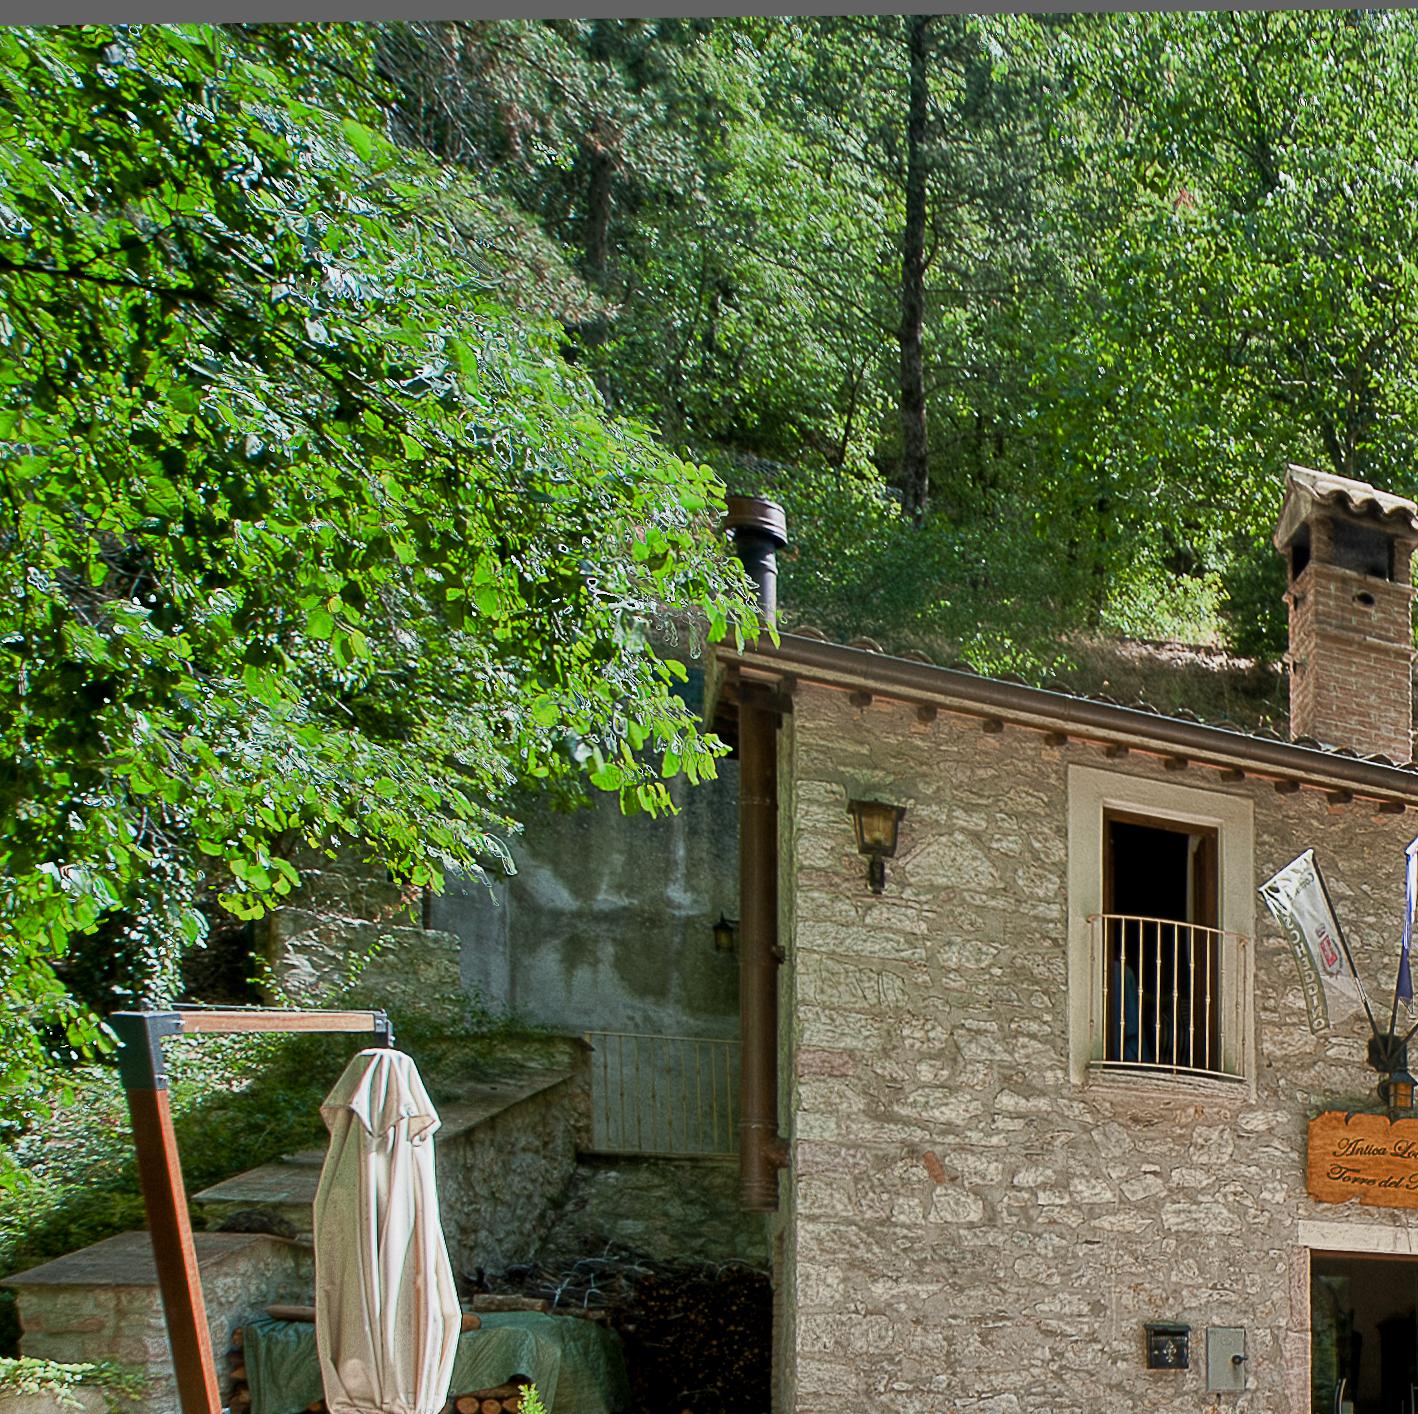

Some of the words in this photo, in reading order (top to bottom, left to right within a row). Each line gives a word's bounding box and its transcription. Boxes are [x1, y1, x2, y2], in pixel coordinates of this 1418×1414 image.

[1332, 1137, 1389, 1158] Antica
[1326, 1163, 1377, 1186] Torre
[1378, 1175, 1402, 1189] del
